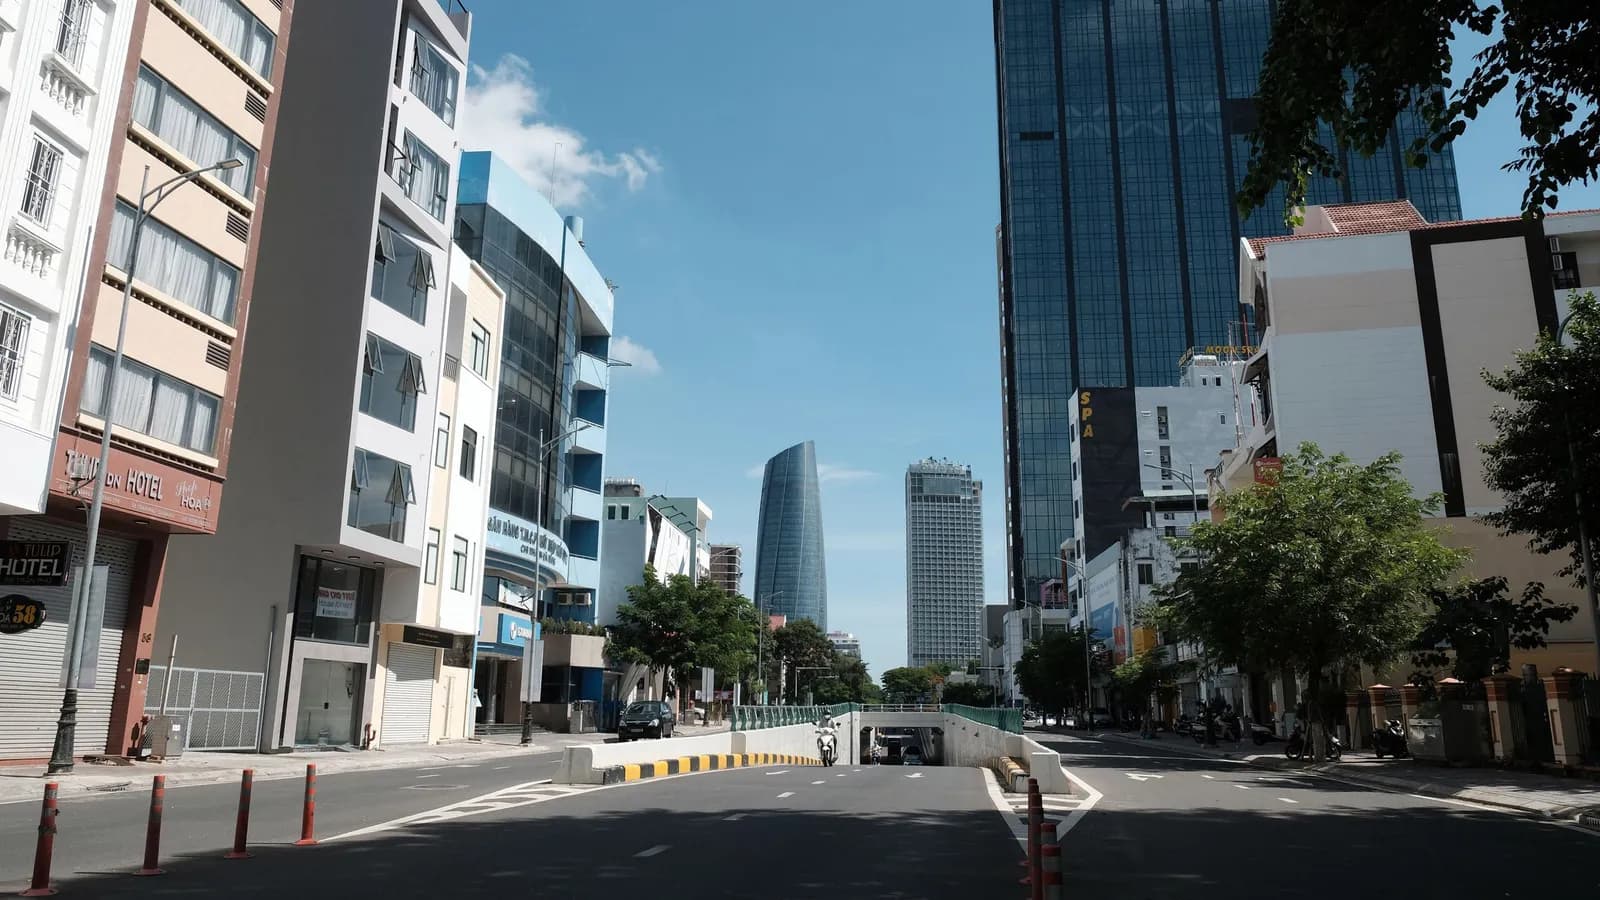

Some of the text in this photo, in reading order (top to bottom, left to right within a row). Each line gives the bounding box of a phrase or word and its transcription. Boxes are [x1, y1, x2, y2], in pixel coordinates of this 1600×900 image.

[1205, 344, 1238, 354] MOON
[1080, 391, 1094, 438] SPA
[65, 449, 101, 482] TIP
[125, 467, 164, 501] HOTEL
[24, 543, 62, 557] TULIP
[0, 558, 63, 577] HOTEL
[12, 603, 37, 624] 58
